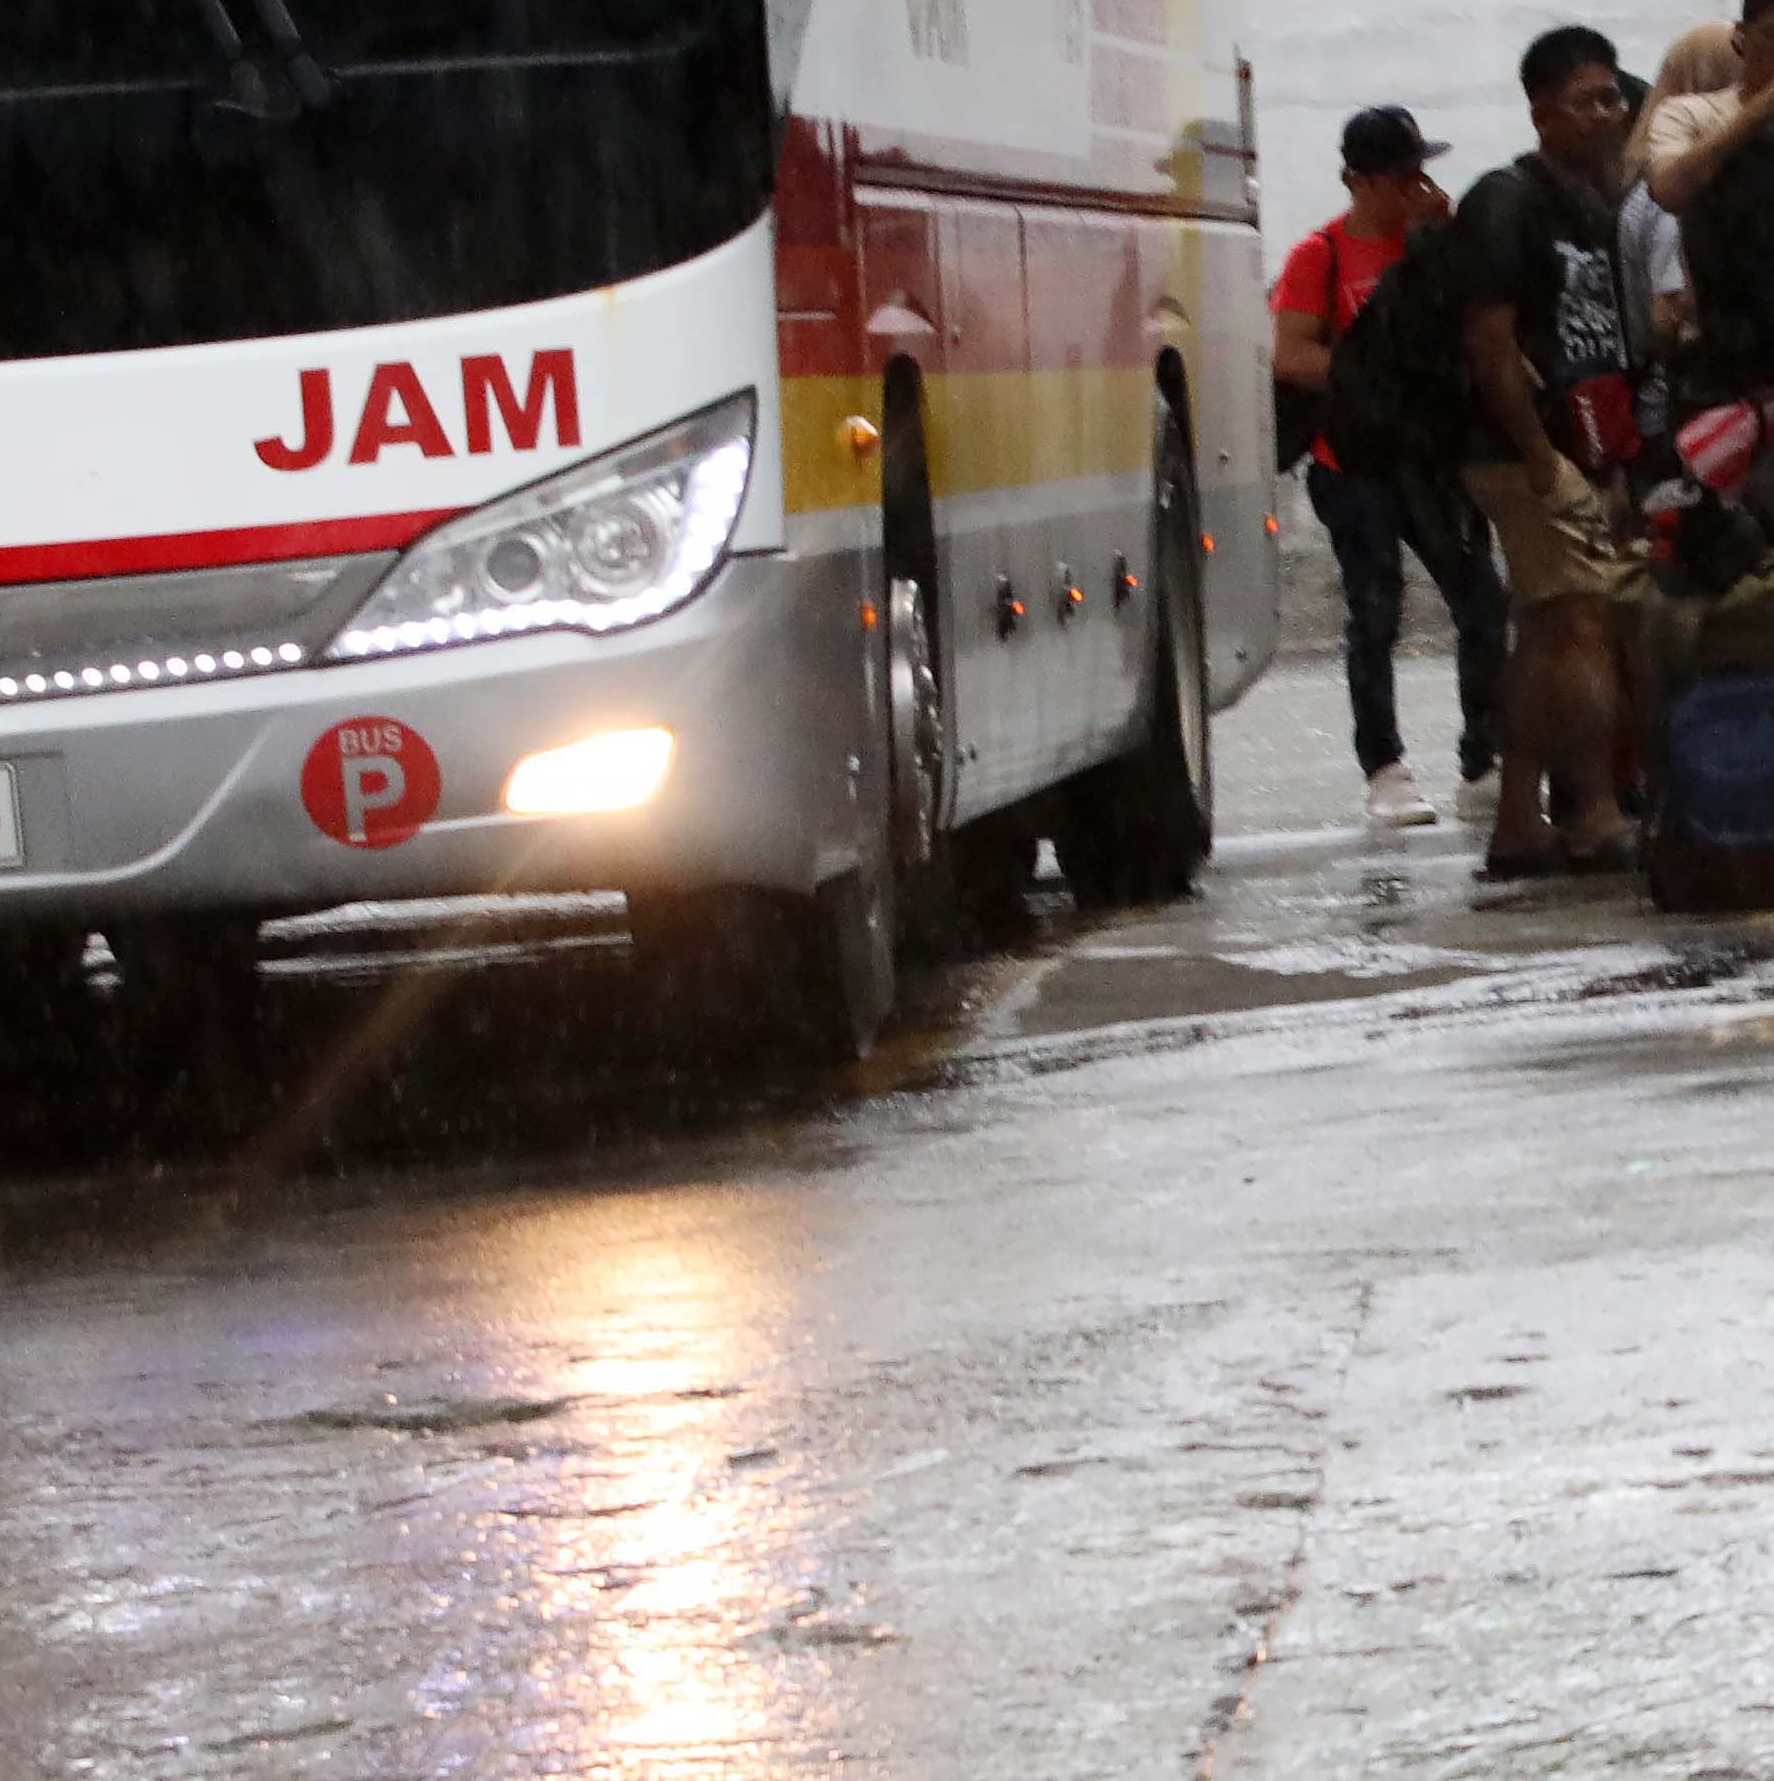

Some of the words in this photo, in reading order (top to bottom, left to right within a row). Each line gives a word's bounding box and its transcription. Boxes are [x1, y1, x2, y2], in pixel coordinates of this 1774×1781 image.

[253, 347, 581, 473] JAM
[337, 725, 404, 756] BUS
[342, 754, 406, 843] P
